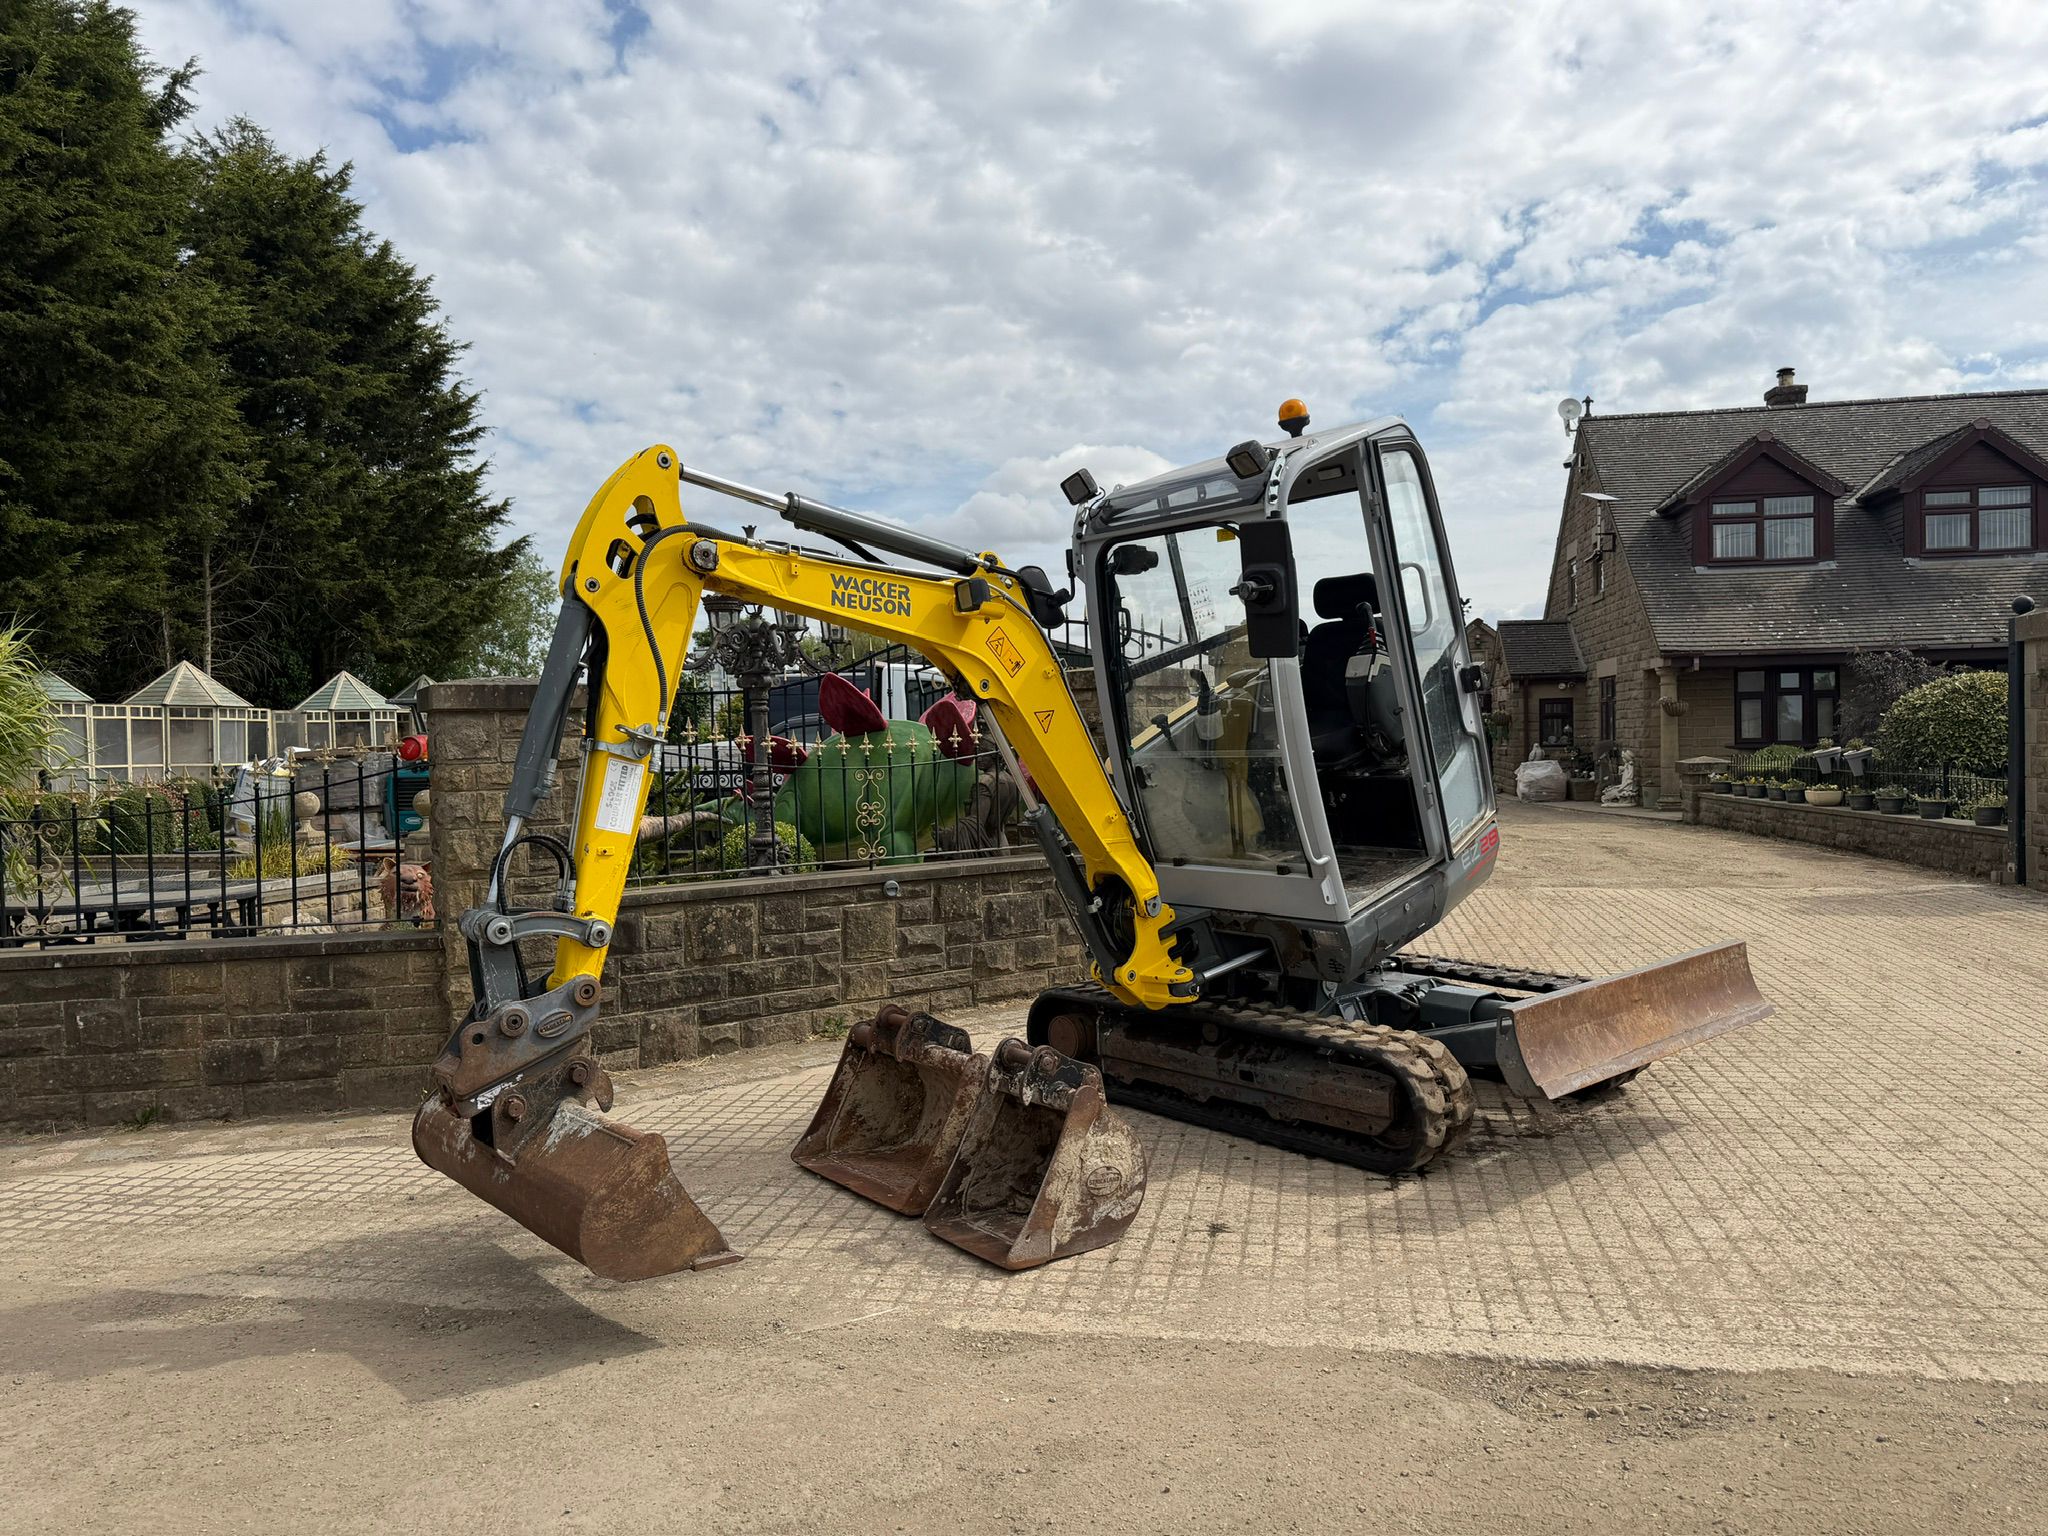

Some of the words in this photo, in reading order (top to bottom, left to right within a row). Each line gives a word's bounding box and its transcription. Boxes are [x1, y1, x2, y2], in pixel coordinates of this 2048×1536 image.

[830, 573, 911, 601] WACKER
[831, 590, 911, 616] NEUSON
[617, 765, 630, 791] FITTED
[1461, 827, 1499, 870] EZ28
